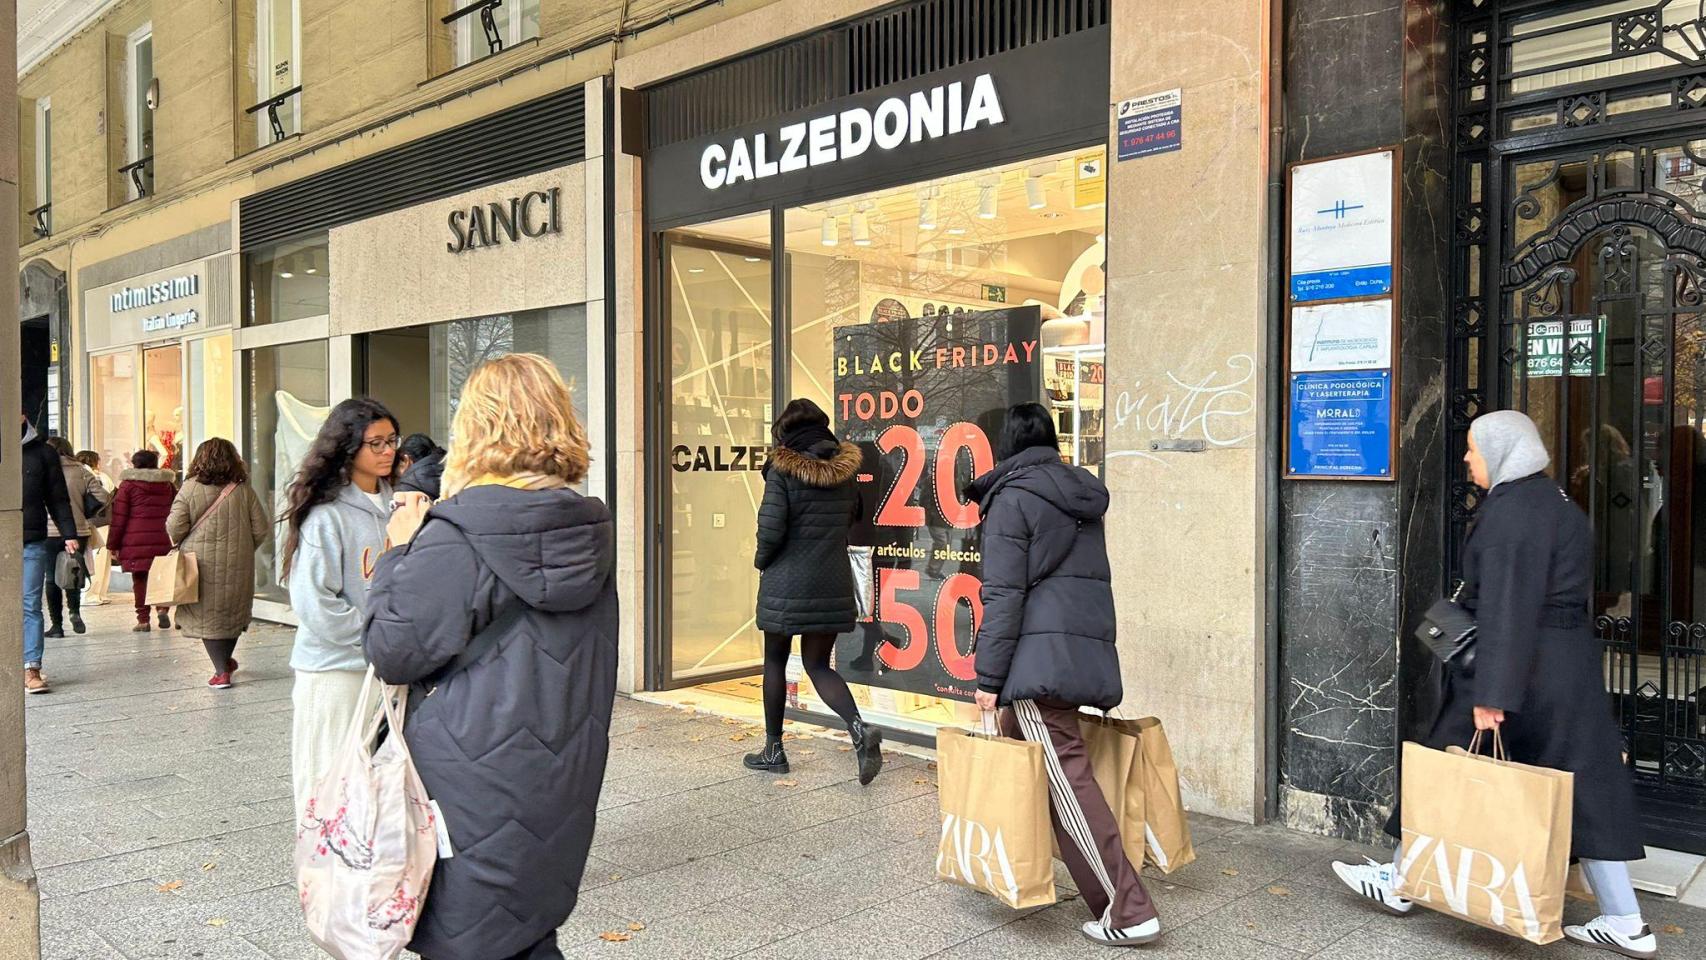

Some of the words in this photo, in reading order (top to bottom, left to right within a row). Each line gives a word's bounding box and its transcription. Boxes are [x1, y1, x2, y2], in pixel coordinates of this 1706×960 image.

[700, 73, 1004, 190] CALZEDONIA
[447, 187, 561, 253] SANCI
[143, 315, 166, 332] Italian
[837, 350, 923, 377] BLACK
[935, 340, 1037, 369] FRIDAY
[1527, 339, 1544, 355] EN
[1527, 358, 1548, 367] 876
[1298, 382, 1329, 391] CLÍNICA
[1330, 381, 1382, 390] PODOLÓGICA
[1316, 389, 1369, 397] LASERTERAPIA
[839, 389, 924, 421] TODO
[672, 445, 771, 472] CALZE
[877, 541, 926, 558] artículos
[936, 810, 1018, 902] ZARA
[1394, 827, 1541, 939] ZARA
